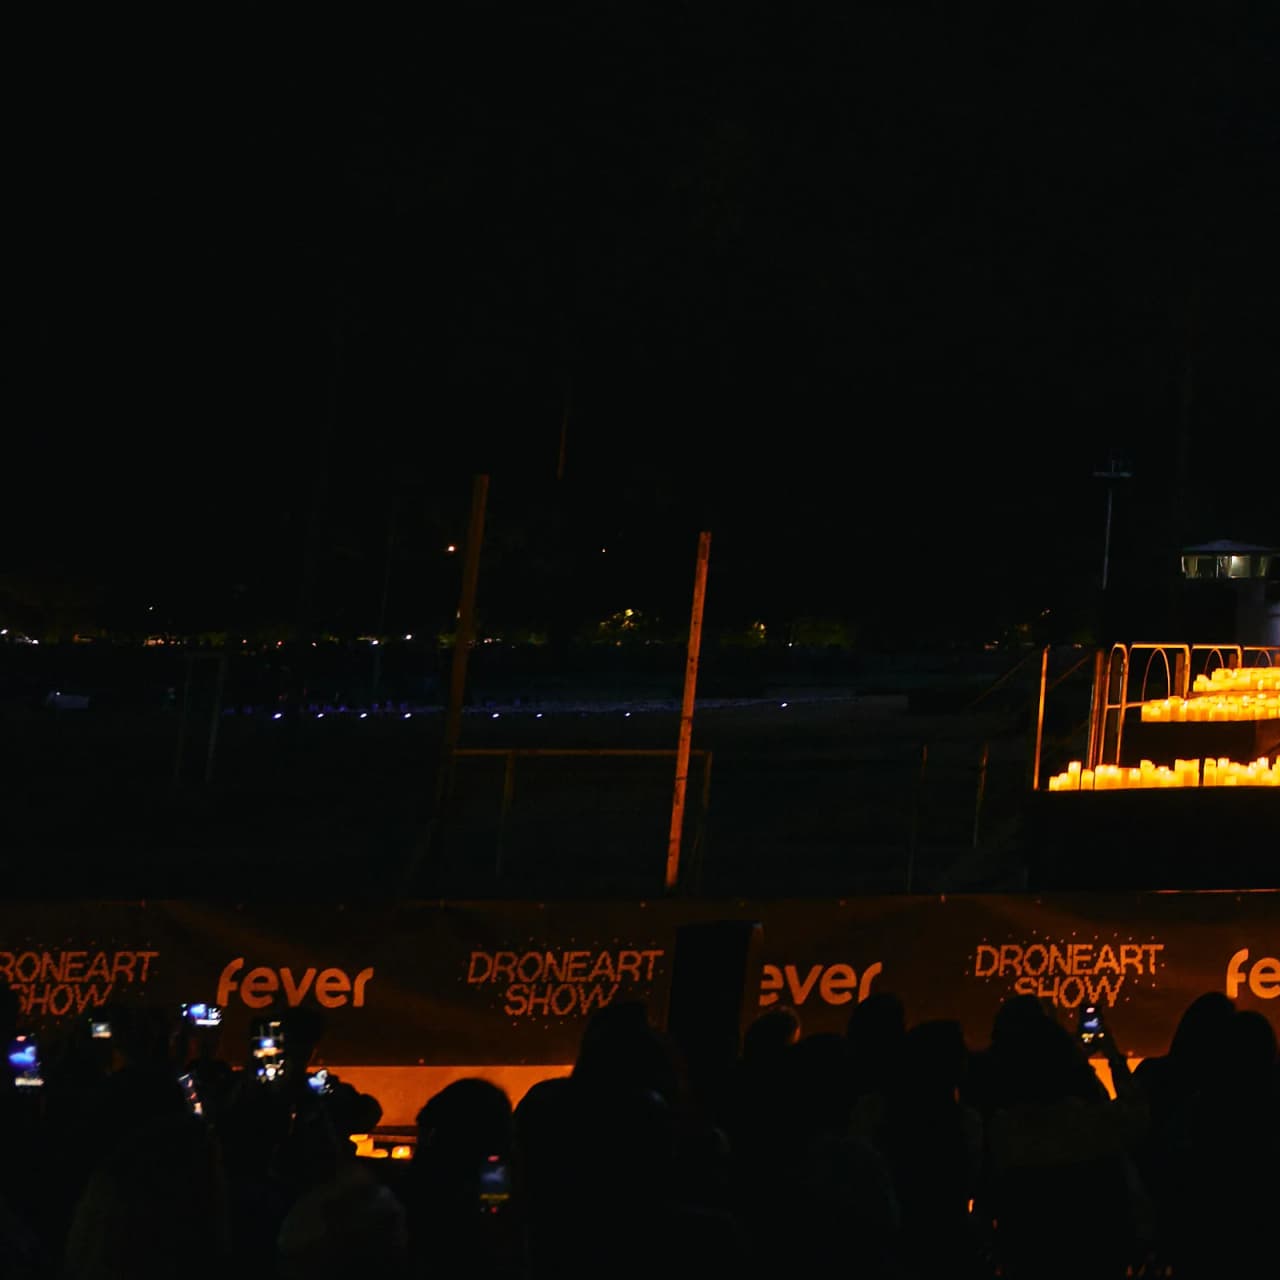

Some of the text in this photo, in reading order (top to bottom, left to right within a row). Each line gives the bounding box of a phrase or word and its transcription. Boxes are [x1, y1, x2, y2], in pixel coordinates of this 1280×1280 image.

[0, 950, 160, 983] RONEART
[467, 949, 664, 984] DRONEART
[975, 943, 1165, 977] DRONEART
[216, 956, 374, 1008] fever
[759, 961, 883, 1007] ever
[1014, 975, 1125, 1009] SHOW
[503, 983, 619, 1017] SHOW
